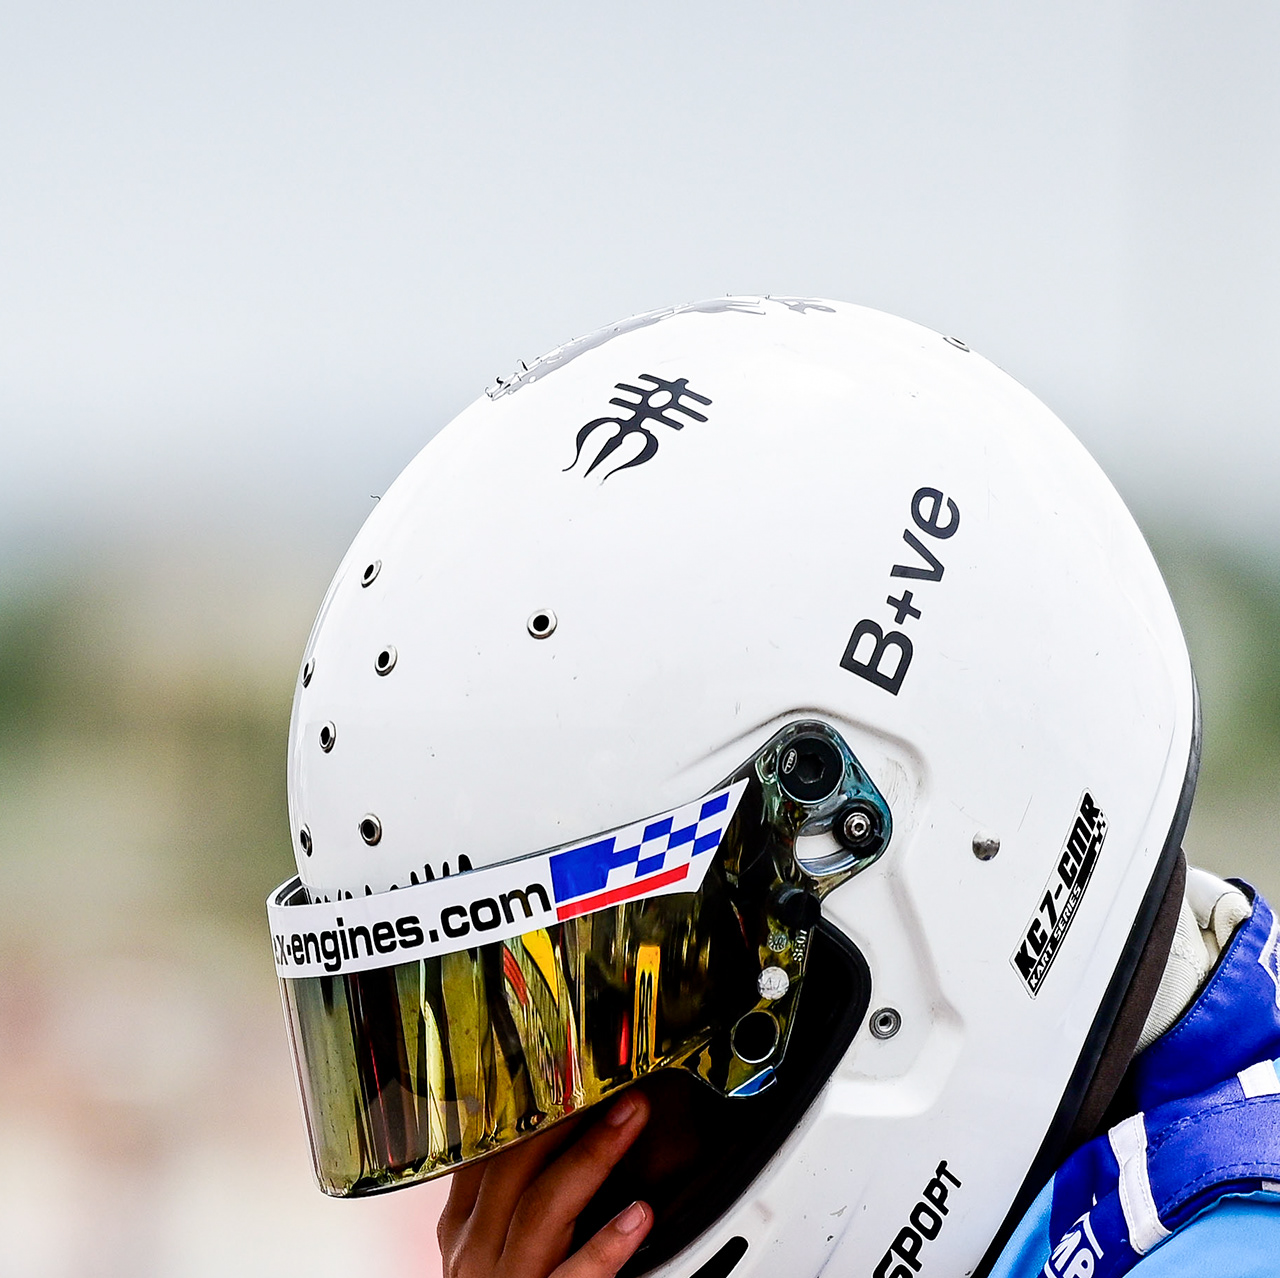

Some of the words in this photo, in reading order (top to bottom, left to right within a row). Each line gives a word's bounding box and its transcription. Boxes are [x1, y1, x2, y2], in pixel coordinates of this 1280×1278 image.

[839, 486, 961, 697] B+ve
[273, 882, 553, 972] x-engines.com
[1029, 944, 1055, 989] KART
[1053, 883, 1081, 942] SERIES
